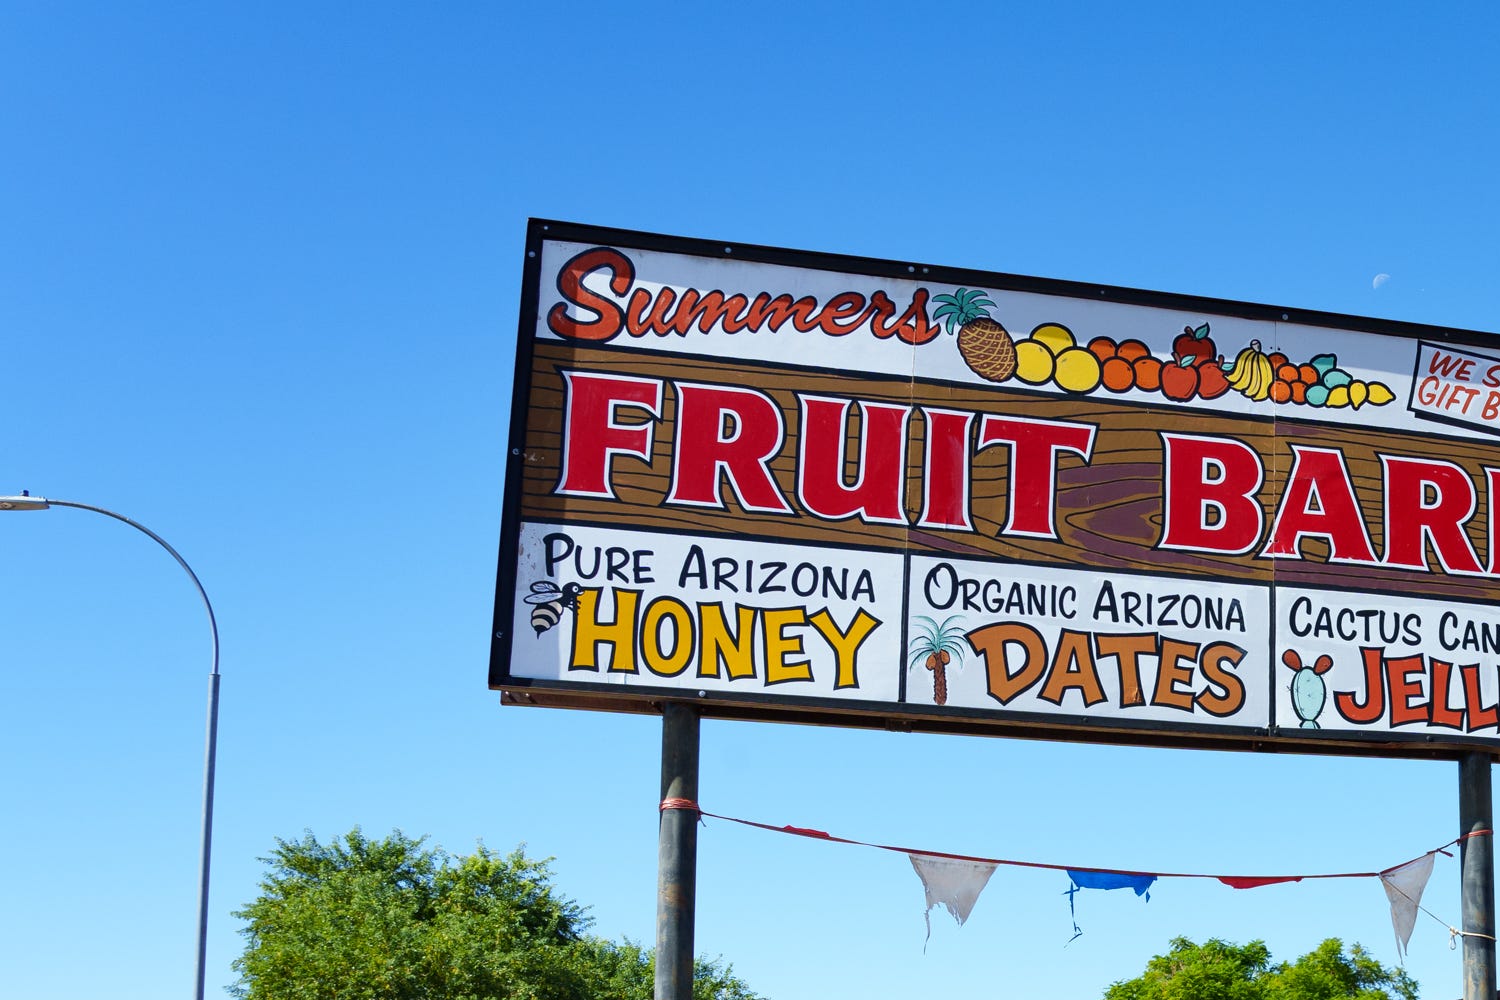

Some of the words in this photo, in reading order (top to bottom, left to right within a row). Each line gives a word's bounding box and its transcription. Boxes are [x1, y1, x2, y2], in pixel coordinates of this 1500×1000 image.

[548, 246, 941, 345] Summers
[1418, 376, 1480, 414] GIFT
[1429, 351, 1476, 382] WE
[554, 368, 1097, 540] FRUIT
[542, 532, 656, 585] PURE
[679, 545, 876, 603] ARIZONA
[924, 562, 1077, 619] ORGANIC
[1093, 580, 1246, 632] ARIZONA
[568, 587, 883, 690] HONEY
[1289, 596, 1422, 646] CACTUS
[964, 621, 1248, 718] DATES
